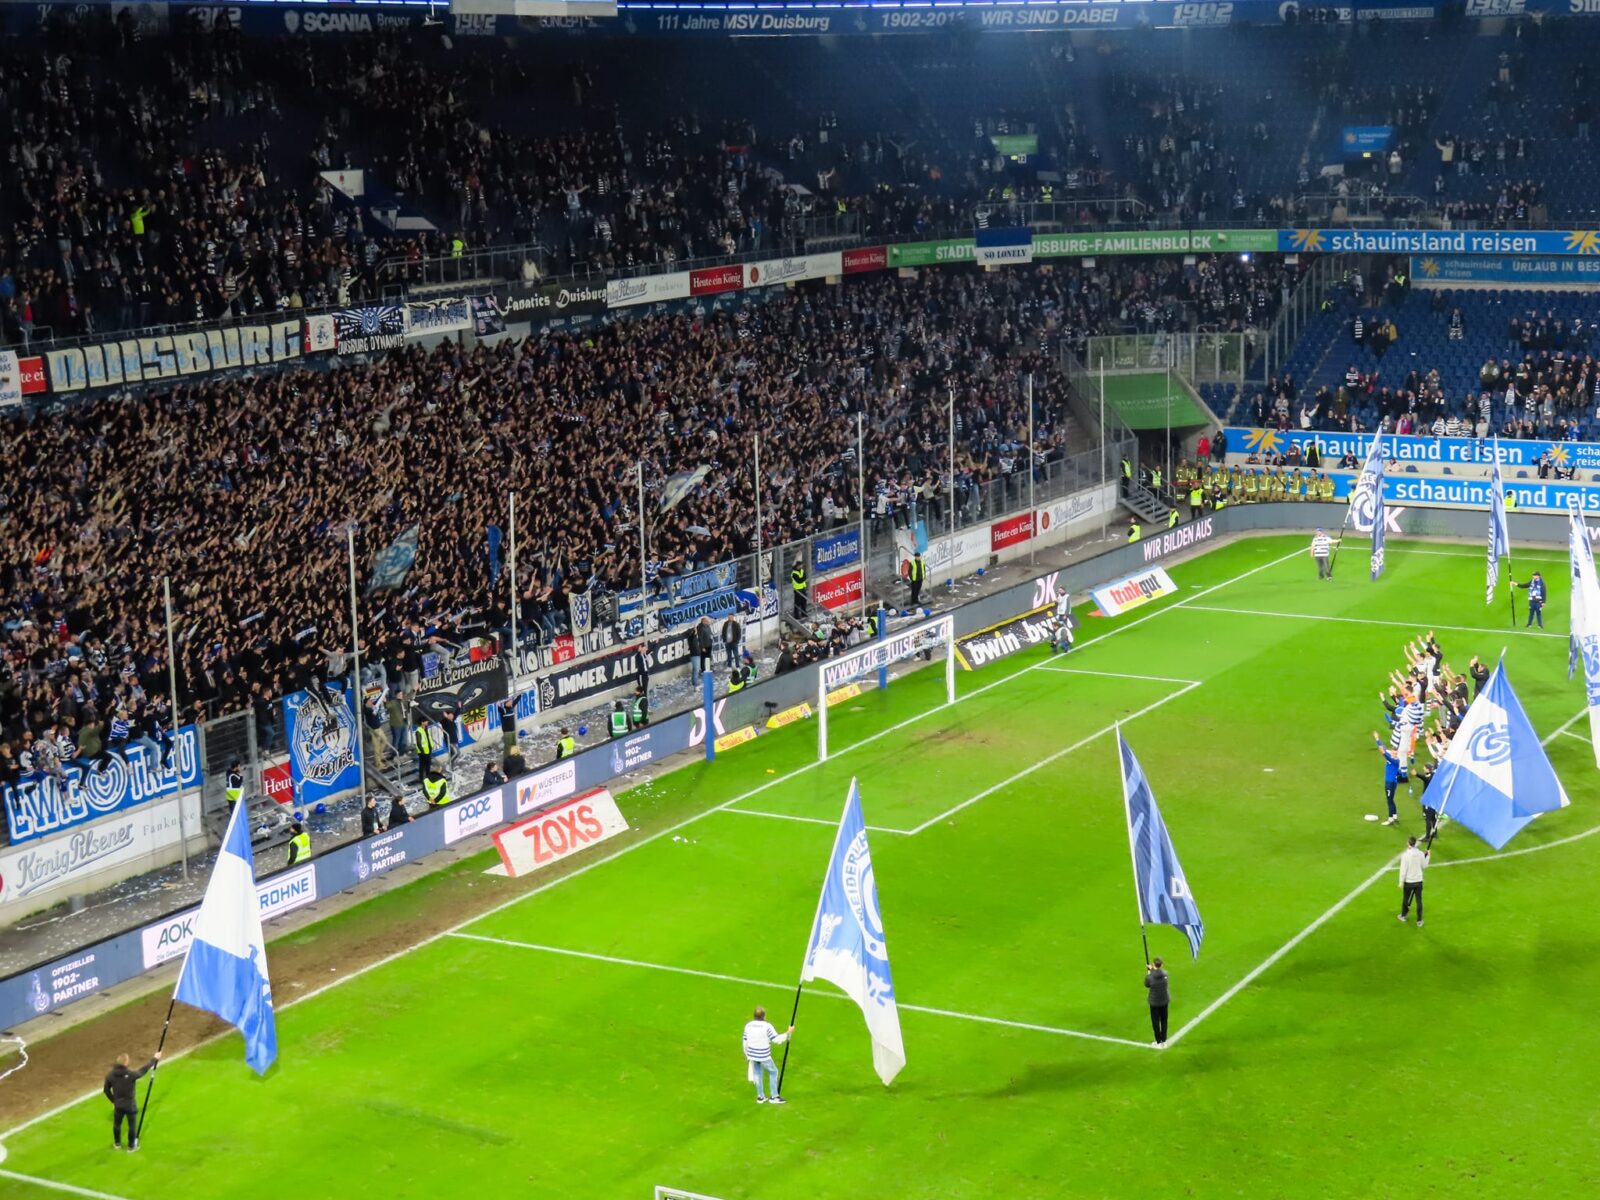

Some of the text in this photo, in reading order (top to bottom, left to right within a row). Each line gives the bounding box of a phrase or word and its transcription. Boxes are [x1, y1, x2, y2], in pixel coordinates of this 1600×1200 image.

[982, 8, 1119, 25] WIR SIND DABEI
[1173, 2, 1234, 20] 1902
[303, 12, 372, 32] SCANIA
[658, 13, 830, 31] 111 Jahre MSV Duisburg
[1332, 232, 1536, 252] schauinsland reisen
[997, 249, 1028, 259] LONELY
[1513, 262, 1557, 272] URLAUB
[1561, 262, 1572, 272] IN
[693, 272, 741, 289] Heute ein König
[556, 287, 609, 308] Duisburg
[338, 334, 404, 355] DUISBURG DYNAMITE
[46, 320, 303, 392] DUISBURG
[1449, 440, 1522, 464] reisen
[994, 529, 1009, 542] Heute
[1143, 518, 1212, 561] WIR BILDEN AUS
[834, 586, 845, 597] ein
[1110, 573, 1161, 606] trinkgut
[969, 631, 1022, 665] bwin
[443, 655, 501, 686] Generation
[558, 665, 608, 697] IMMER
[612, 650, 654, 680] ALLS
[626, 751, 653, 768] PARTNER
[538, 769, 574, 791] WÜSTEFELD
[459, 797, 491, 825] pape
[371, 831, 404, 849] OFFIZIELLER
[522, 805, 605, 865] ZOXS
[16, 849, 70, 889] König
[70, 823, 134, 866] Pilsener
[371, 846, 393, 860] 1902-
[372, 851, 406, 872] PARTNER
[260, 877, 309, 910] ROHNE
[157, 918, 193, 949] AOK
[52, 954, 95, 977] OFFIZIELLER
[53, 973, 80, 990] 1902-
[53, 977, 99, 1004] PARTNER
